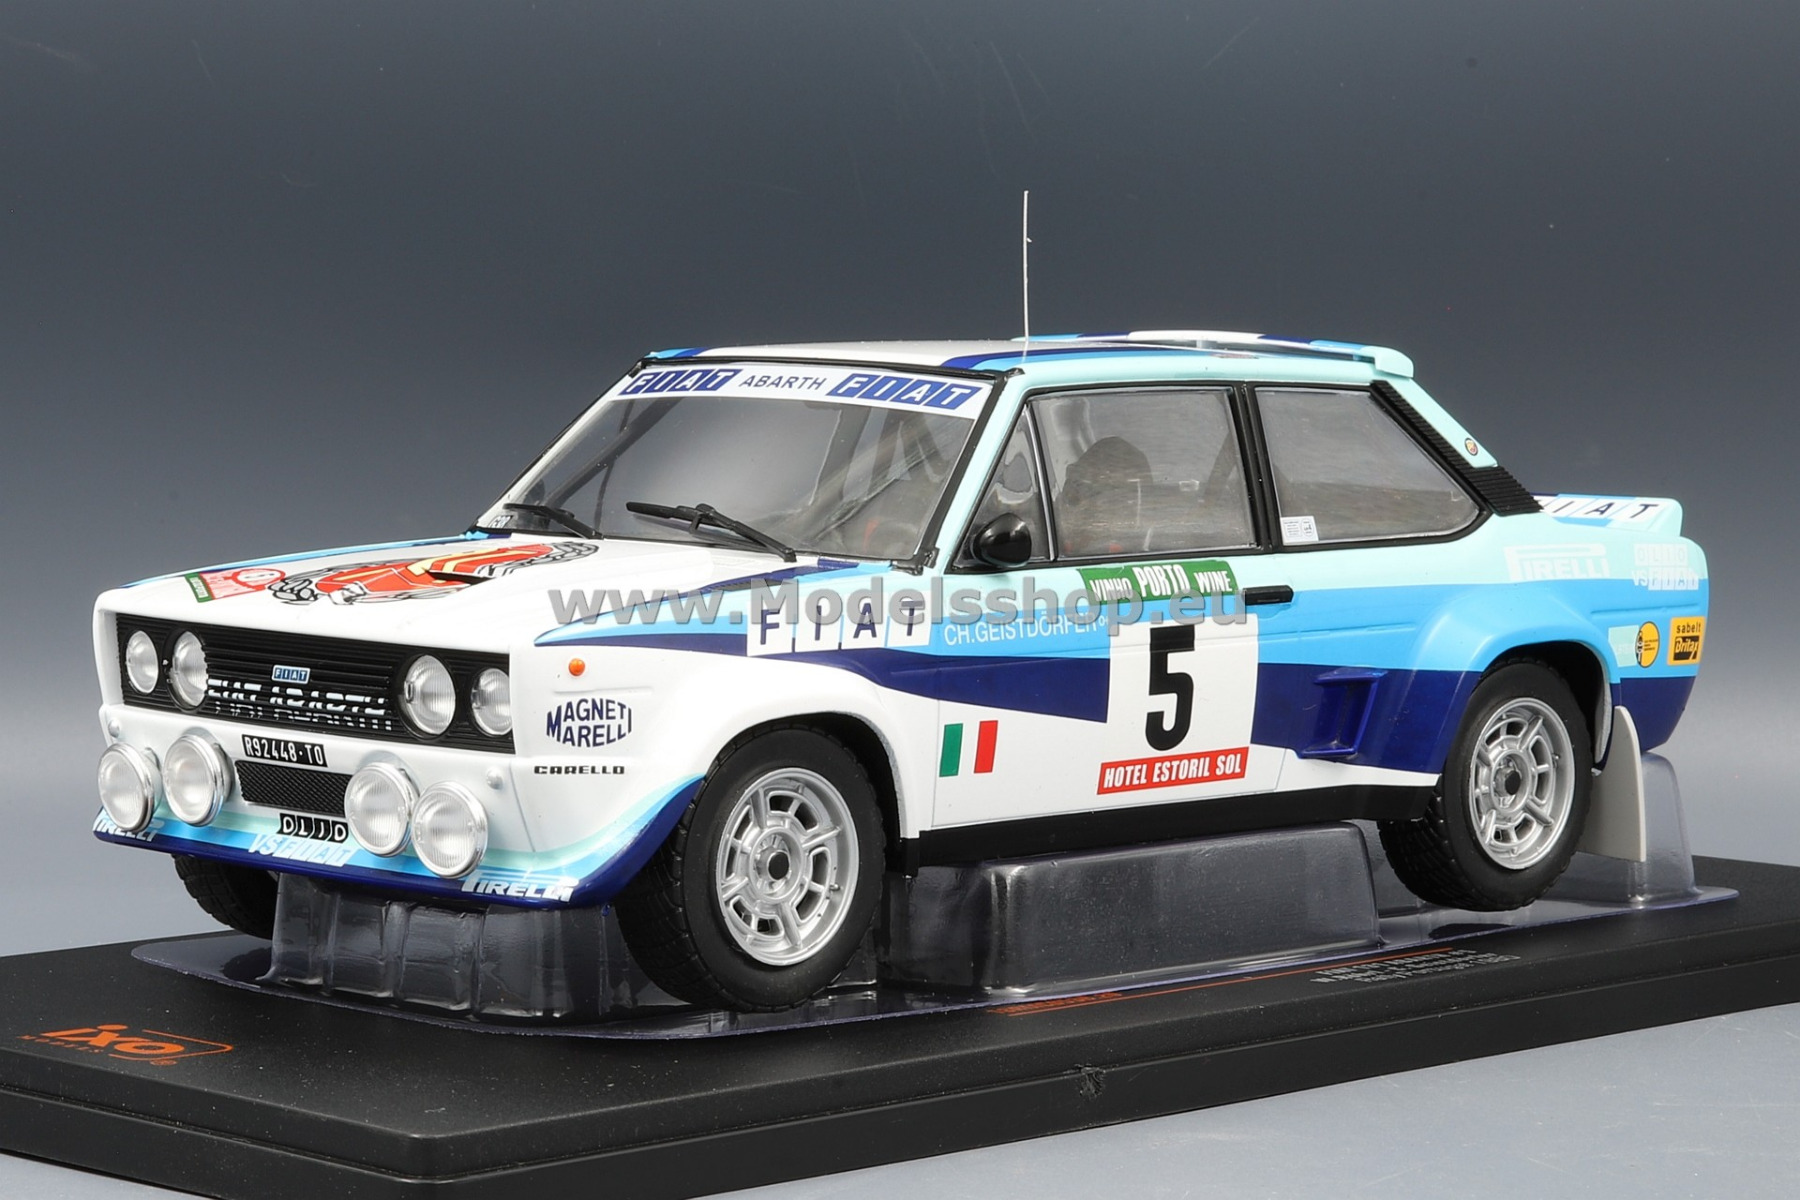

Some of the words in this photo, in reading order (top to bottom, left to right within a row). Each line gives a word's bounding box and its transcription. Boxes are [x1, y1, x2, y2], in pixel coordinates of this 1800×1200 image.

[620, 369, 742, 395] FIAT
[738, 374, 828, 391] ABARTH
[828, 373, 980, 408] FIAT
[1546, 499, 1659, 519] IAT
[1504, 543, 1611, 582] PIRELLI
[1635, 544, 1688, 566] OLIO
[1088, 577, 1133, 601] VINHO
[1133, 564, 1191, 598] PORTO
[1193, 570, 1233, 594] WINE
[760, 600, 924, 645] FIAT
[1676, 622, 1701, 634] sabelt
[1674, 637, 1700, 659] Britax
[273, 666, 309, 681] FIAT
[1145, 624, 1195, 751] 5
[534, 765, 625, 775] CARELLO
[1103, 764, 1148, 789] HOTEL
[1152, 757, 1210, 783] ESTORIL
[1215, 753, 1242, 775] SOL
